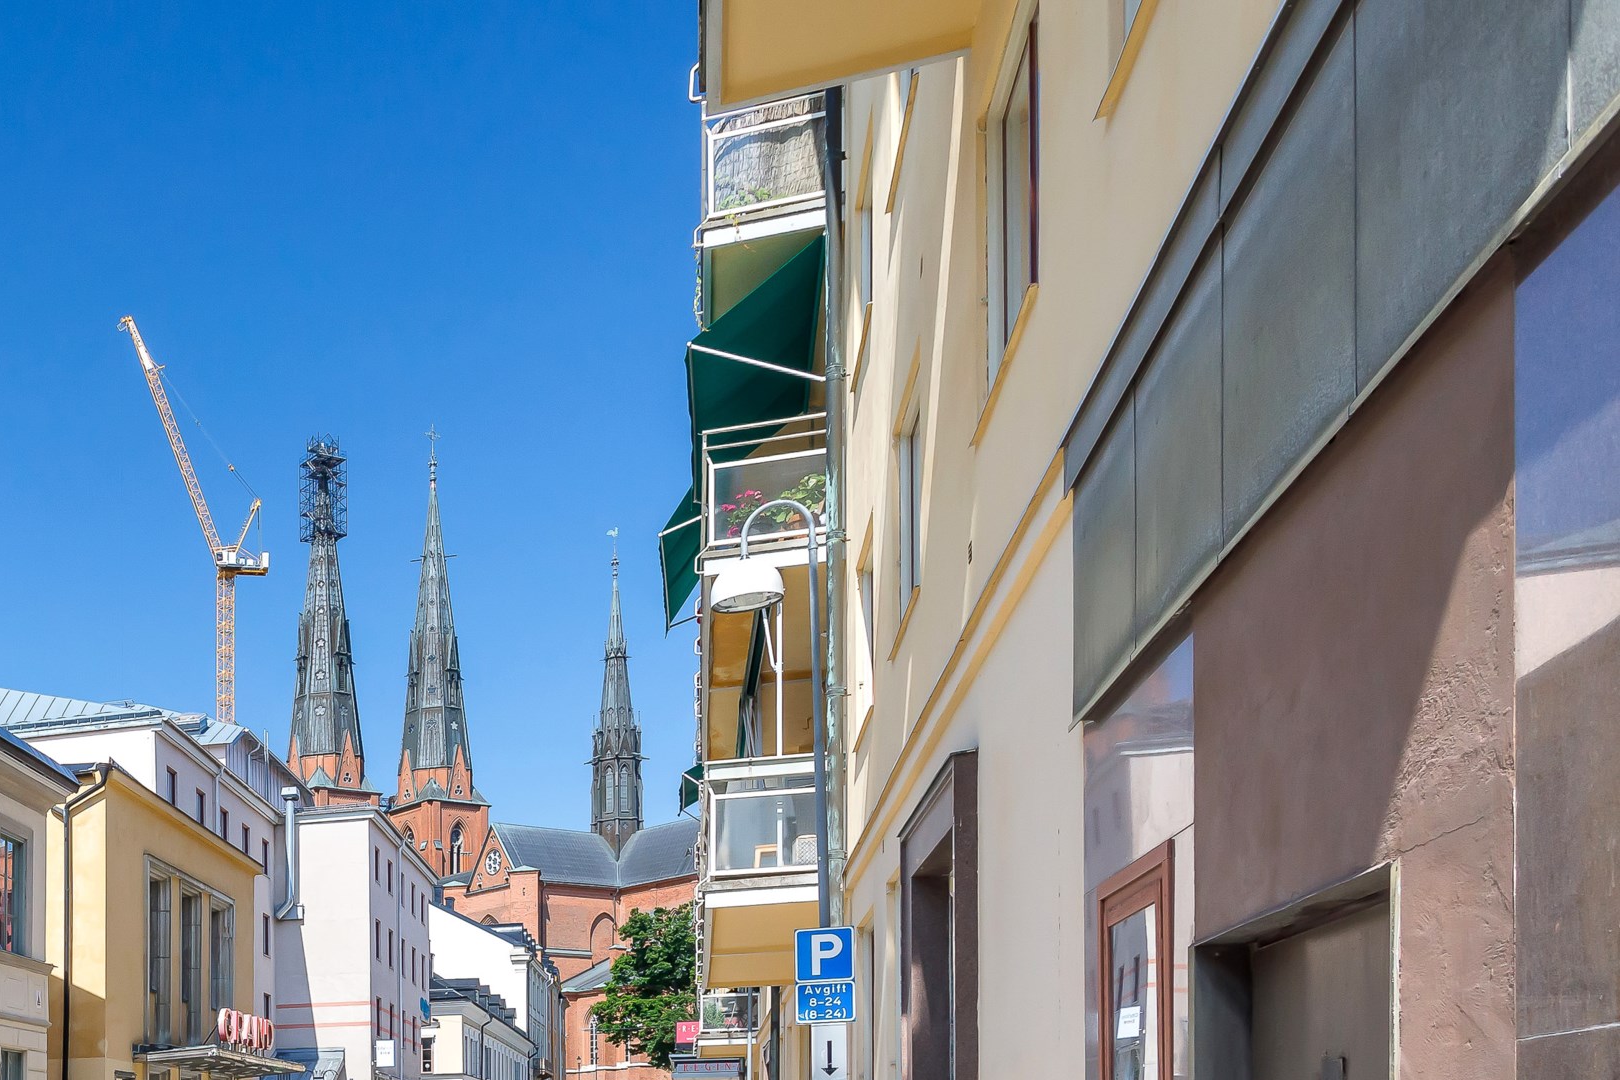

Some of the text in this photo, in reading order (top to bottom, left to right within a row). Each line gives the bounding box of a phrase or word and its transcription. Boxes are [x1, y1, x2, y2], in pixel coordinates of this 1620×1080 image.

[811, 933, 844, 976] P
[804, 984, 847, 996] Avgift
[809, 996, 842, 1007] 8-24
[804, 1007, 847, 1020] (8-24)
[218, 1008, 274, 1051] GRAND
